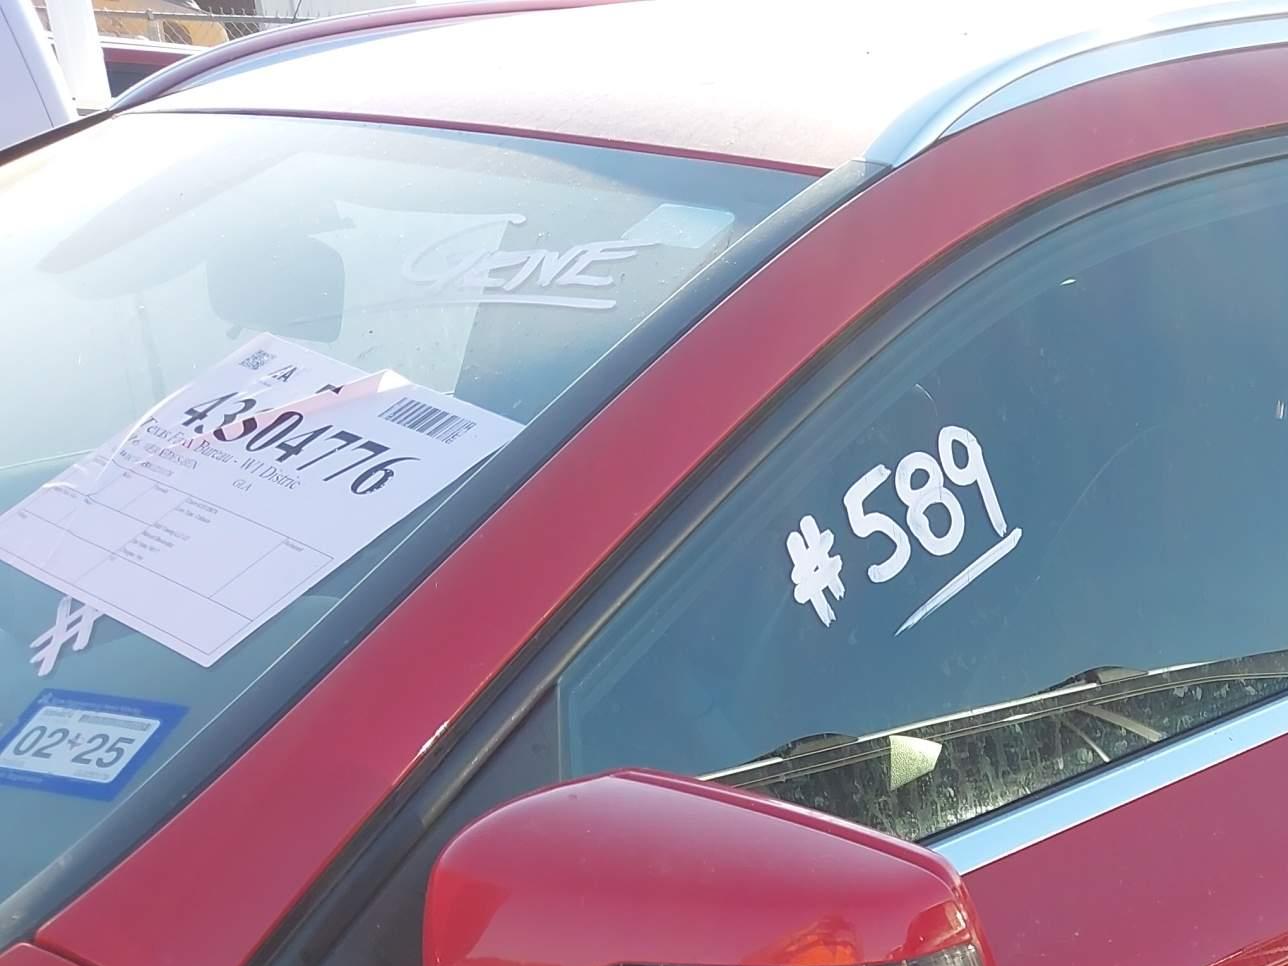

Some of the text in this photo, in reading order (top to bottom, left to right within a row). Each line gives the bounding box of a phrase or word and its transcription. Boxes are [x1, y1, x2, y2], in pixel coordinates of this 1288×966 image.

[193, 440, 233, 464] Bureau
[786, 425, 1008, 628] #589
[13, 725, 135, 768] 02 25
